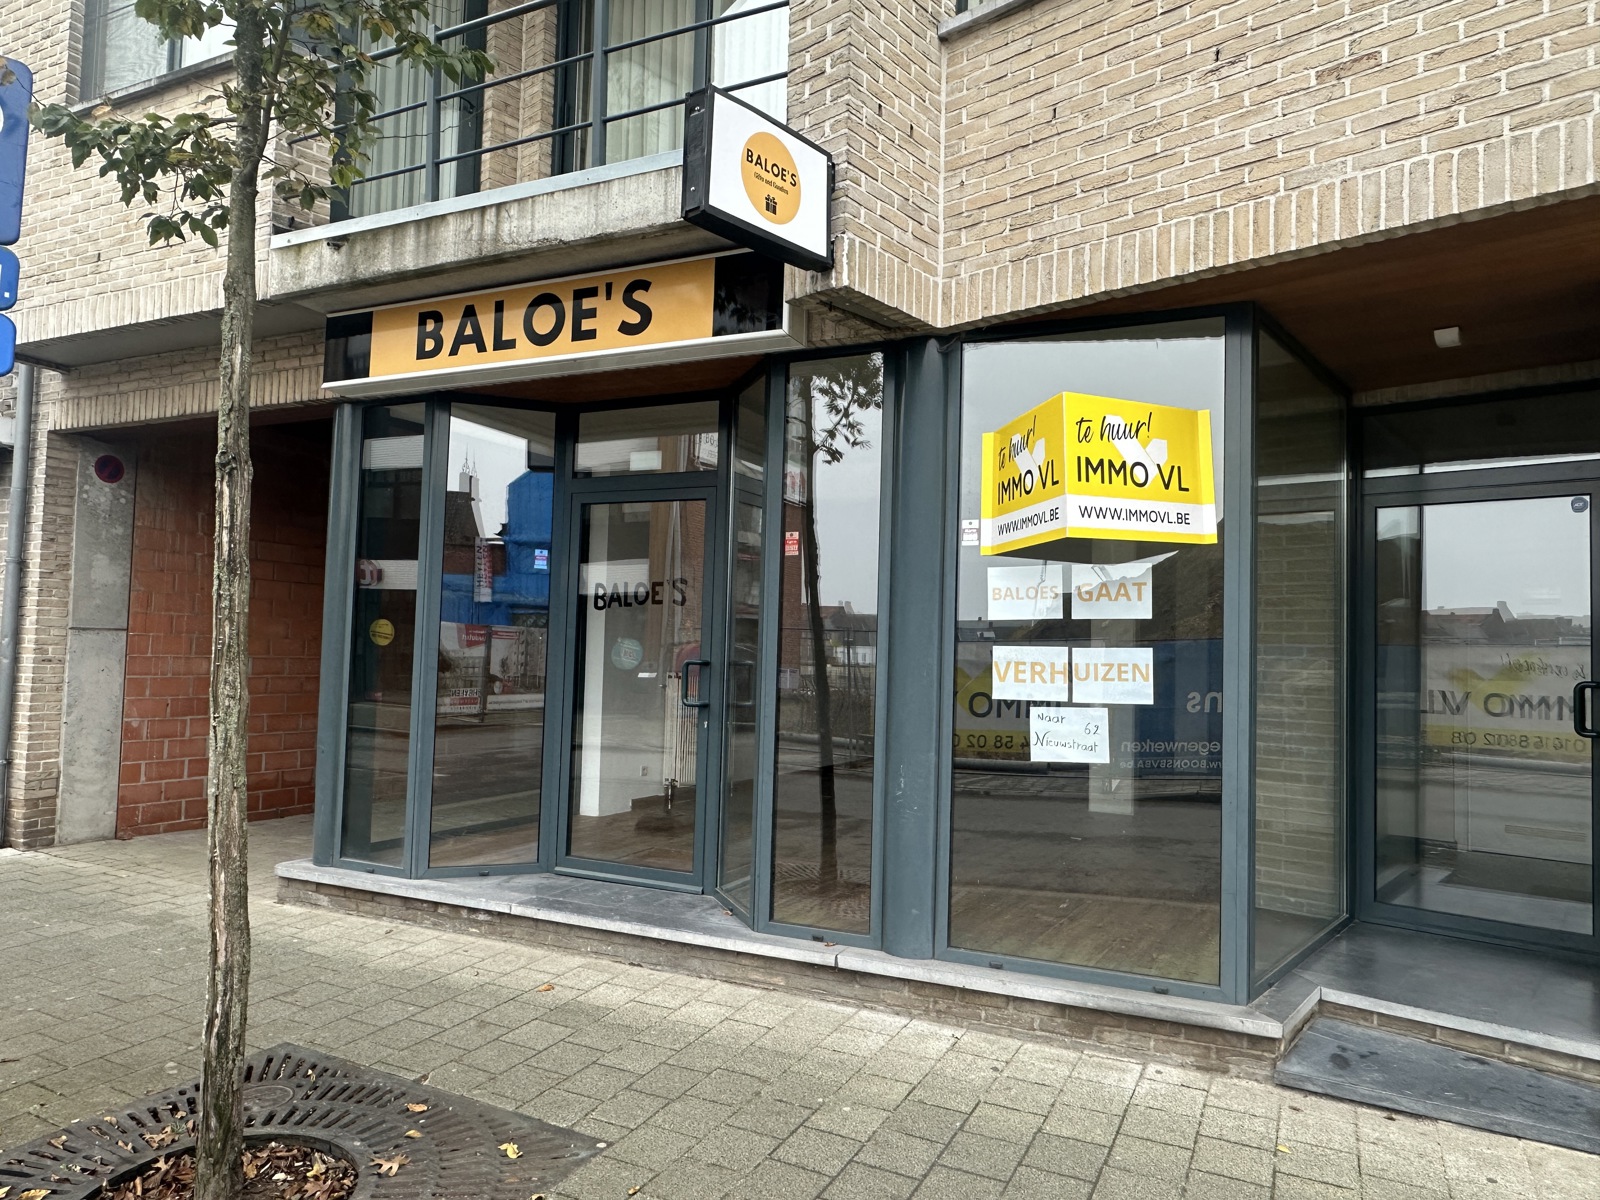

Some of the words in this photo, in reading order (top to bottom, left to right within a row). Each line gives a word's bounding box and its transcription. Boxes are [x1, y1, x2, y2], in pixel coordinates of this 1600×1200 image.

[746, 148, 797, 187] BALOE'S
[416, 279, 653, 361] BALOE'S
[998, 445, 1006, 471] te
[1008, 414, 1037, 463] huur!
[1075, 416, 1094, 445] te
[1100, 411, 1153, 443] huur!
[997, 468, 1034, 506] IMMO
[1038, 458, 1060, 491] VL
[1076, 455, 1149, 488] IMMO
[1157, 463, 1190, 493] VL
[997, 506, 1060, 537] WWW.IMMOVL.BE
[1078, 504, 1191, 526] WWW.IMMOVL.BE
[593, 577, 689, 611] BALOE'S
[992, 584, 1059, 601] BALOES
[1076, 582, 1148, 602] GAAT
[1037, 713, 1066, 725] Naar
